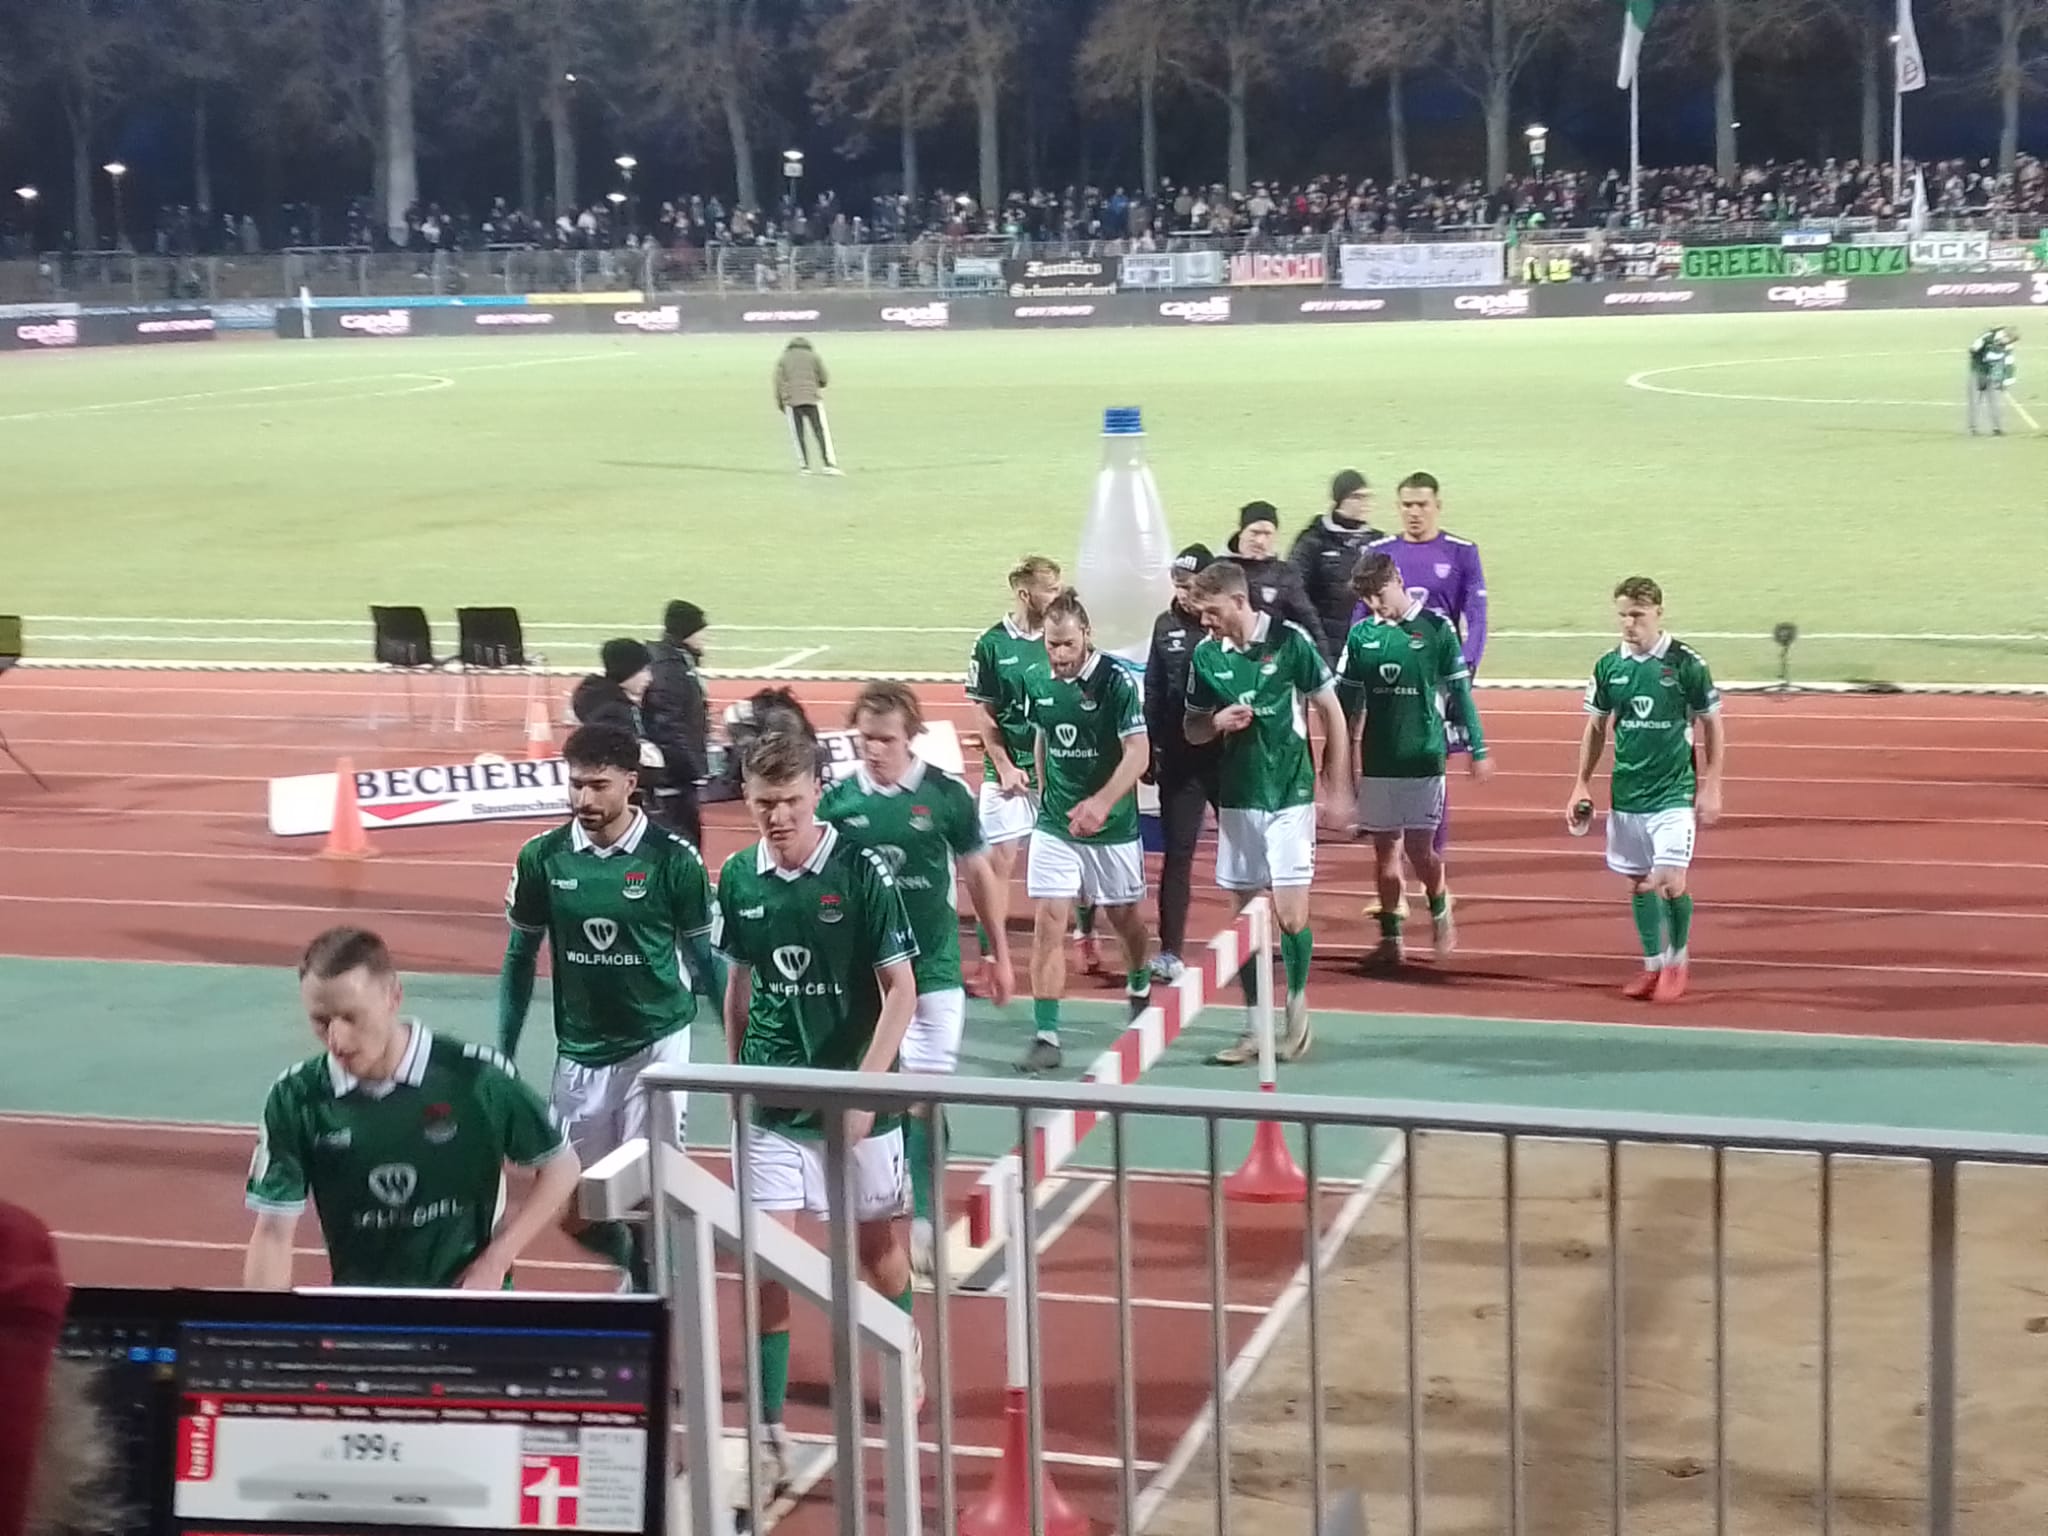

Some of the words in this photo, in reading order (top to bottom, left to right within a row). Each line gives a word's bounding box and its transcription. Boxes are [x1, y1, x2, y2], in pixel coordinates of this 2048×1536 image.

[1686, 246, 1784, 277] GREEN
[1824, 246, 1905, 274] BOYZ
[354, 759, 569, 799] BECHERT
